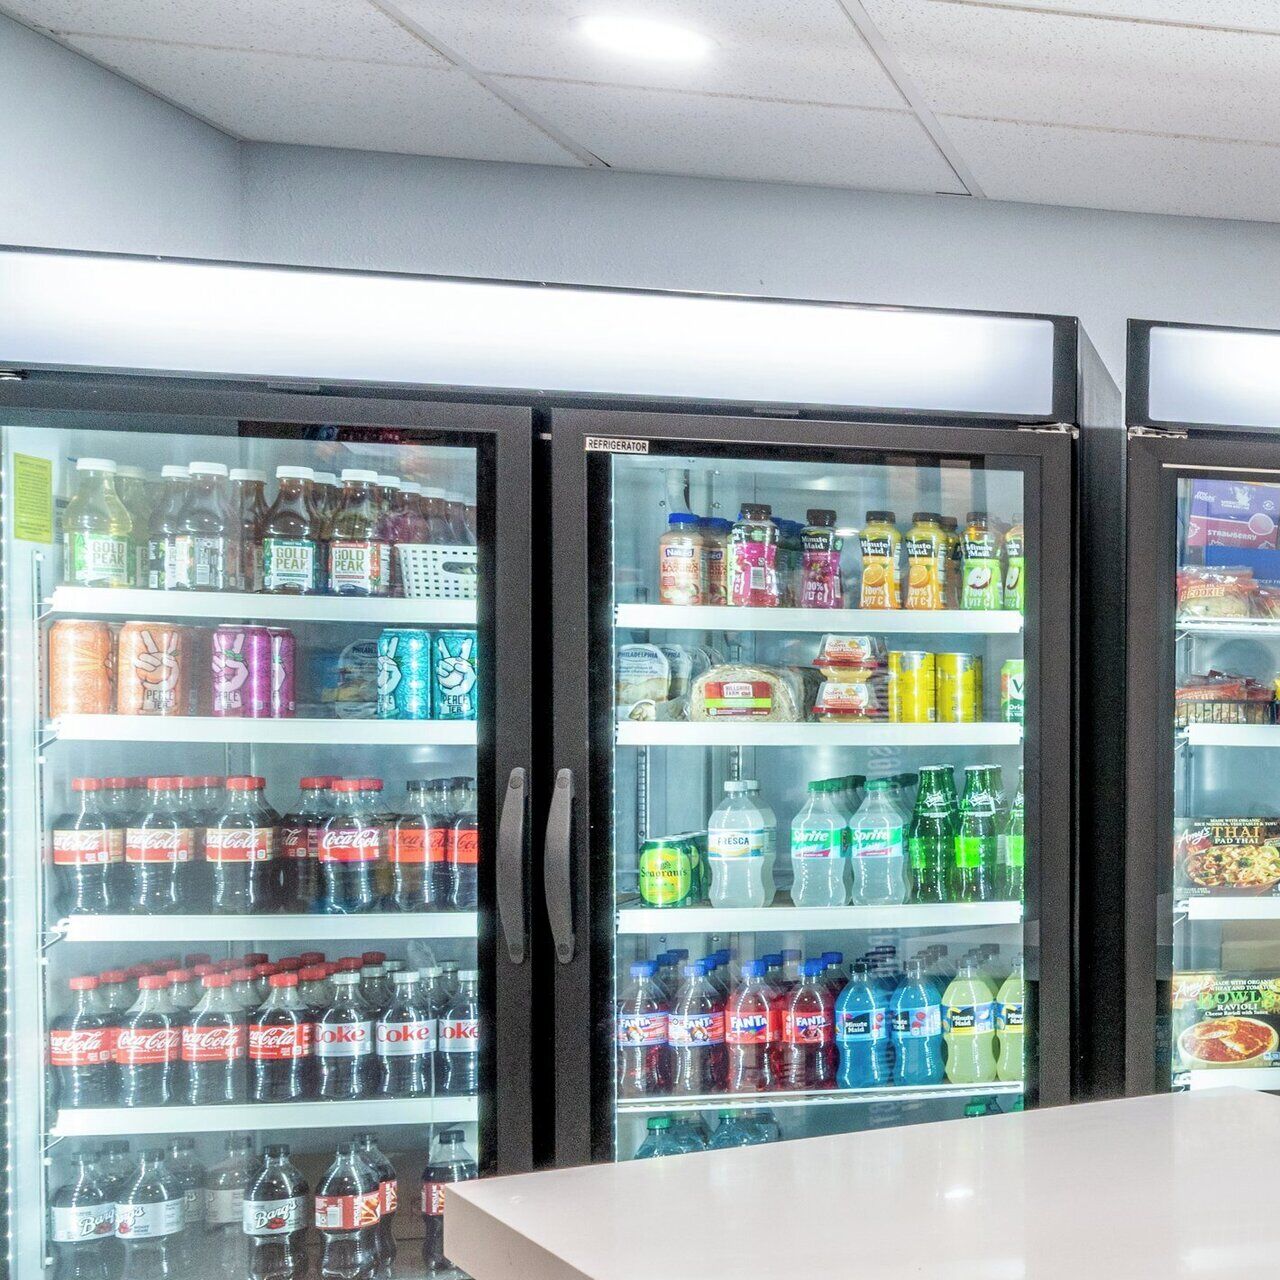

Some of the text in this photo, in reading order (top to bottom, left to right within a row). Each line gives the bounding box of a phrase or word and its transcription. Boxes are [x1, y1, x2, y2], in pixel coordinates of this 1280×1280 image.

[588, 439, 647, 452] REFRIGERATOR
[1208, 530, 1256, 541] STRAWBERRY
[92, 542, 124, 551] GOLD
[276, 547, 308, 558] GOLD
[92, 553, 125, 564] PEAK
[276, 559, 307, 569] PEAK
[335, 561, 364, 571] PEAK
[792, 830, 829, 844] Sprite
[853, 830, 889, 842] Sprite
[1177, 828, 1211, 847] Amy's
[1212, 827, 1259, 837] THAI
[718, 837, 749, 845] FRESCA
[641, 866, 688, 878] Seagram's
[1197, 991, 1274, 1009] BOWLS
[730, 1016, 768, 1027] FANTA
[796, 1016, 826, 1026] FANTA
[953, 1014, 974, 1022] Minute
[954, 1019, 972, 1027] Maid
[315, 1025, 365, 1043] Coke
[377, 1025, 429, 1042] Coke
